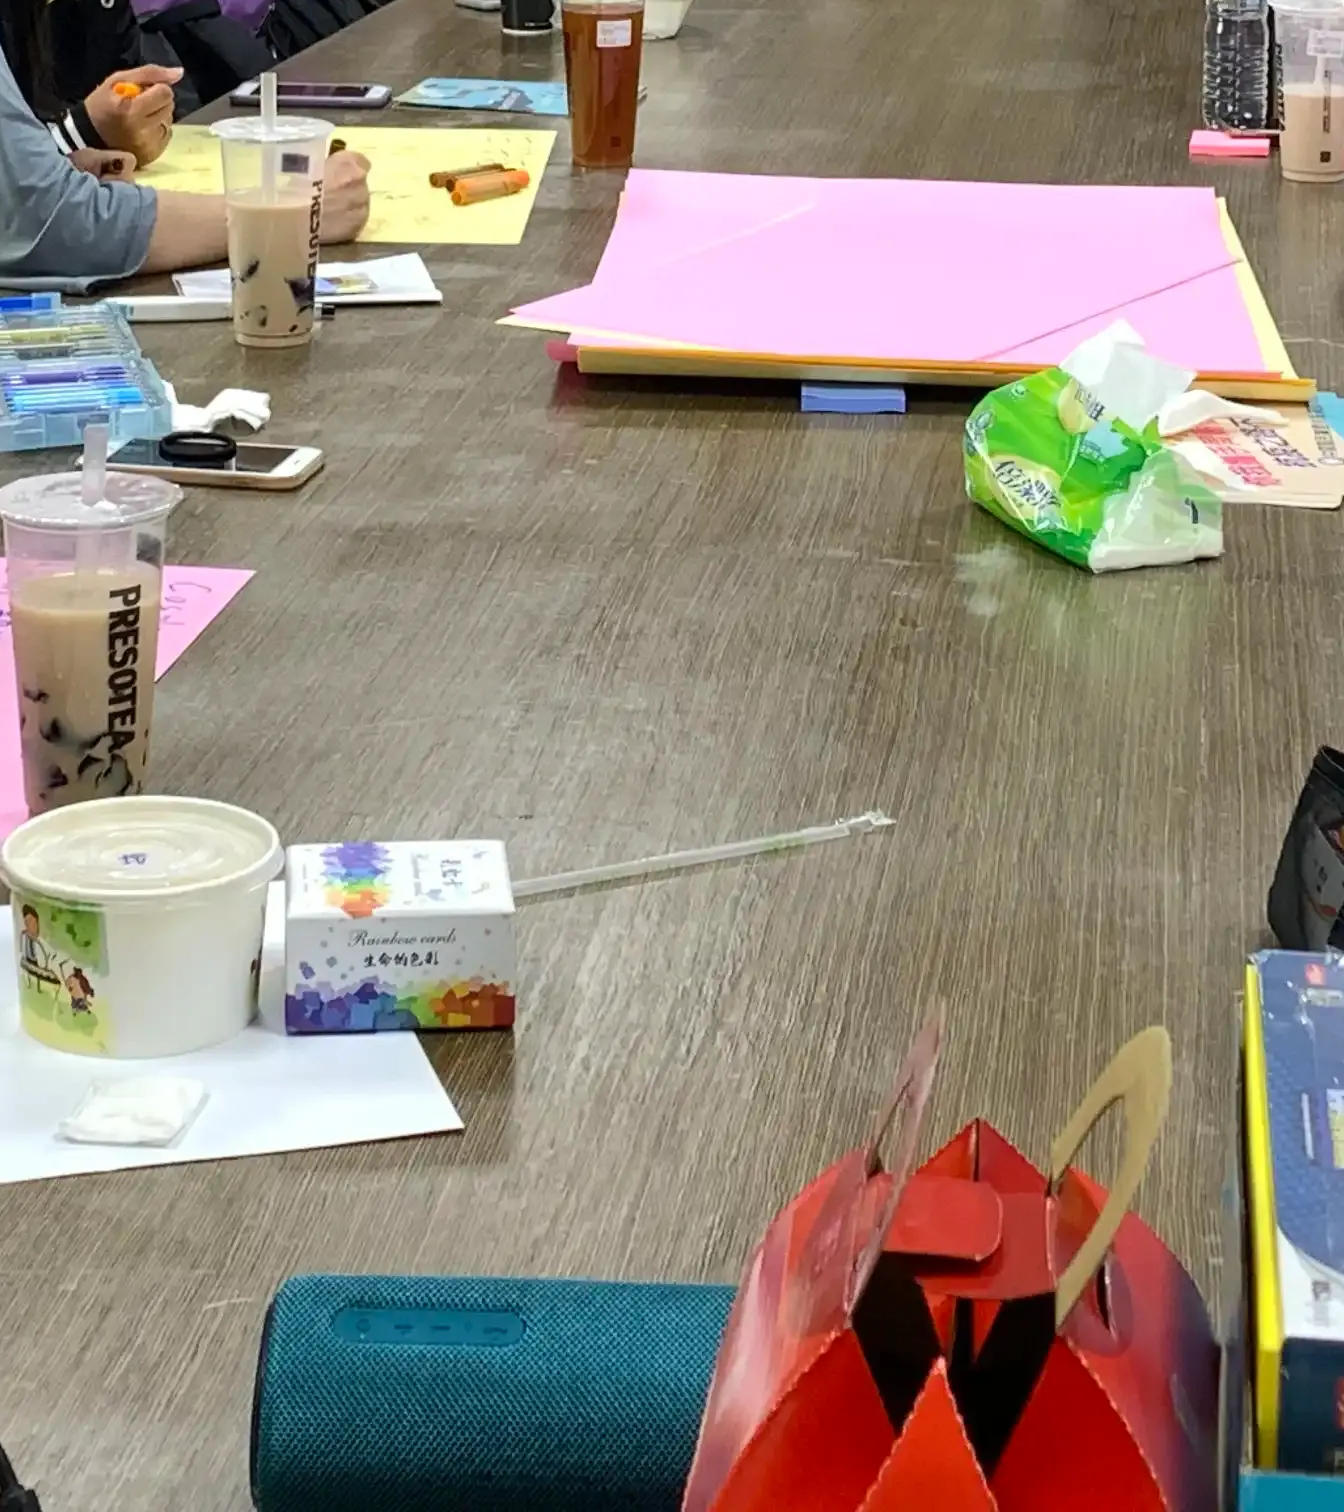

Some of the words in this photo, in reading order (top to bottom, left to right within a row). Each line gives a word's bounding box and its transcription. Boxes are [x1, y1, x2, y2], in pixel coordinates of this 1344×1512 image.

[109, 584, 141, 755] PRESOTEA
[347, 929, 417, 948] Rainbow
[364, 950, 439, 968] 生命的色彩
